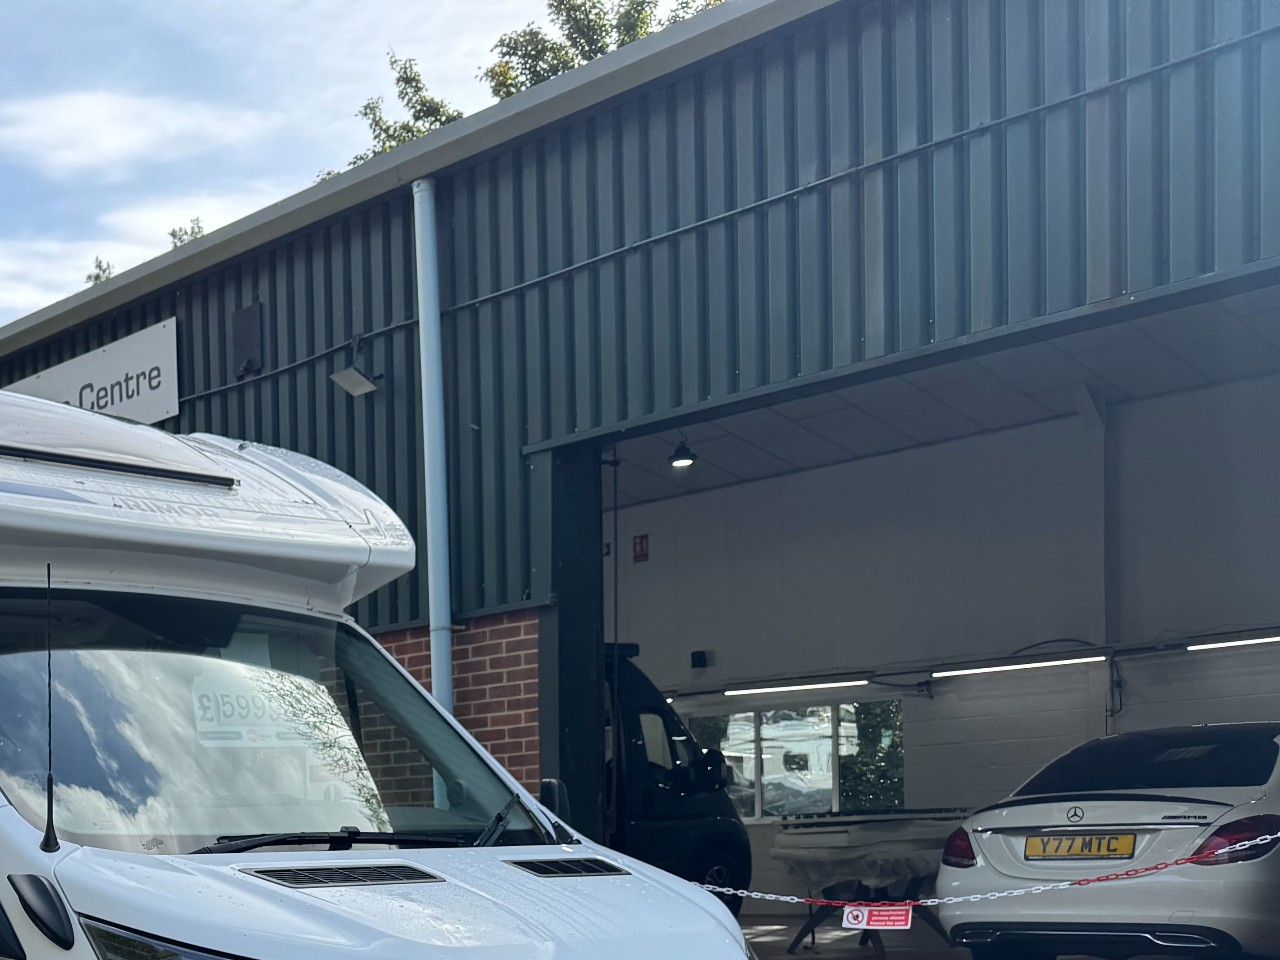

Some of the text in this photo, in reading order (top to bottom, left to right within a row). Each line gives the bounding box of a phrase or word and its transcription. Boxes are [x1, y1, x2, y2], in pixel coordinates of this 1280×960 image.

[79, 366, 161, 410] Centre
[1041, 837, 1118, 854] Y77 MTC
